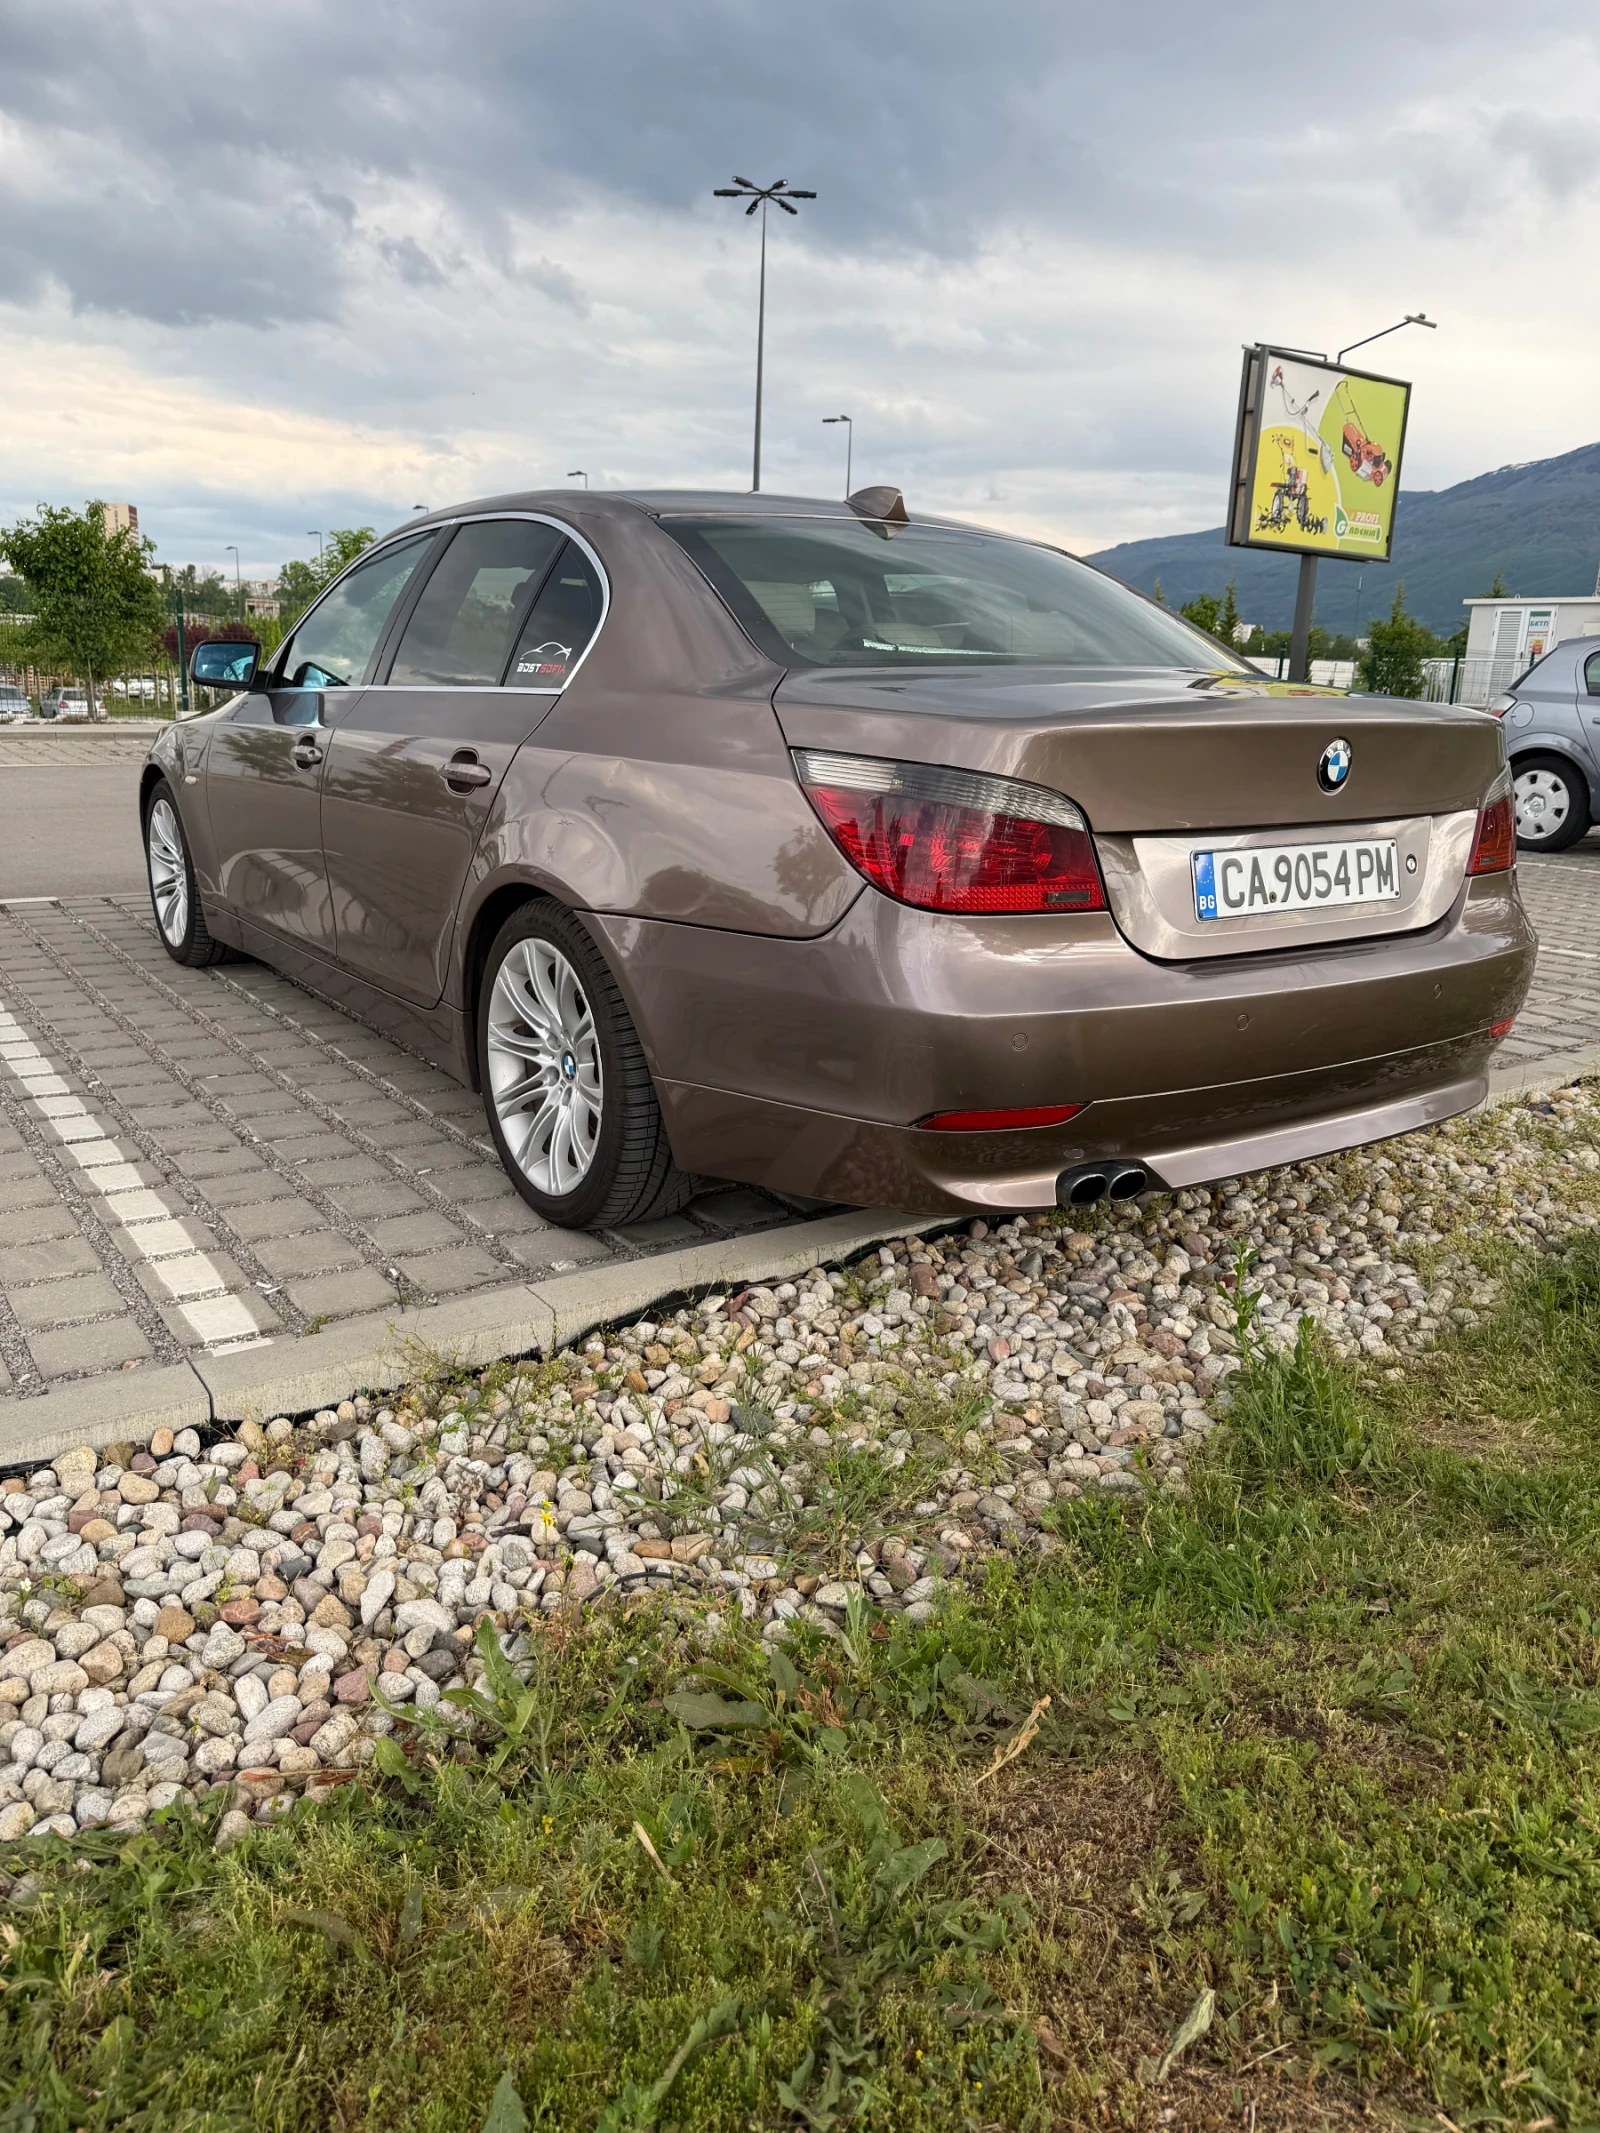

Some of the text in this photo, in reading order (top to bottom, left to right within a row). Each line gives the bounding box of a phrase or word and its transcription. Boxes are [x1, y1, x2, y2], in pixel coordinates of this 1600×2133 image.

[1355, 511, 1380, 524] PROFI
[1325, 741, 1352, 759] BMW
[1199, 895, 1215, 910] BG
